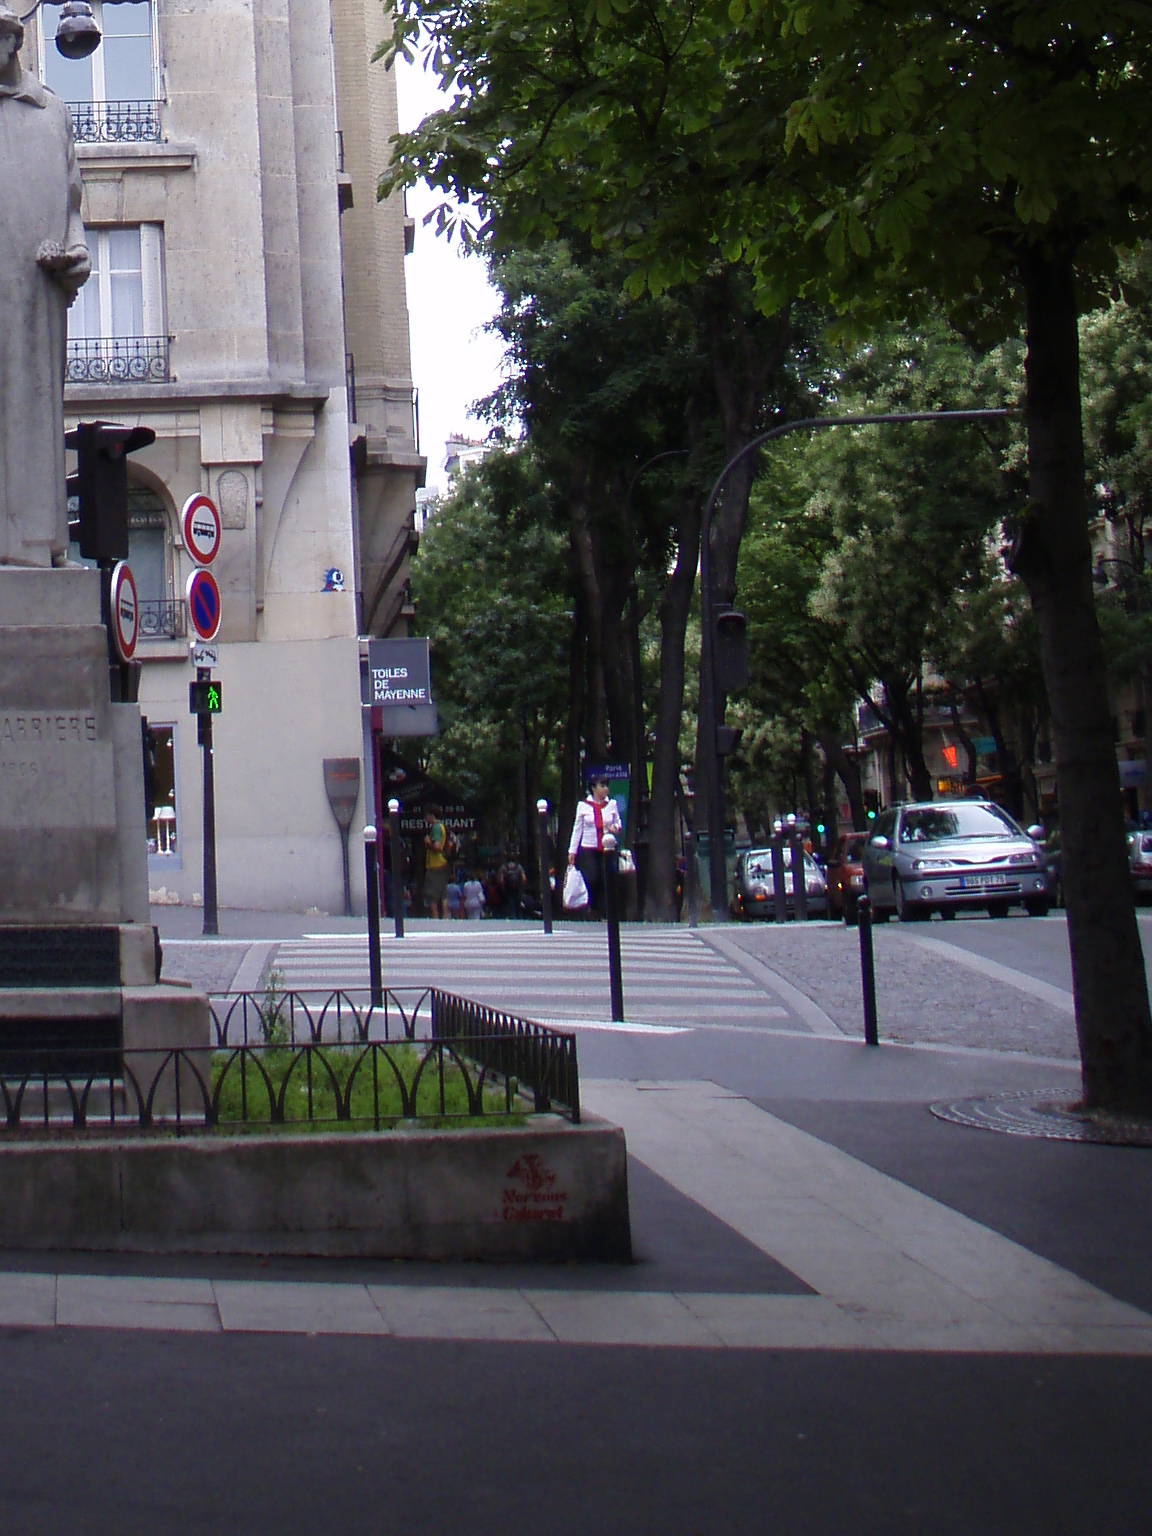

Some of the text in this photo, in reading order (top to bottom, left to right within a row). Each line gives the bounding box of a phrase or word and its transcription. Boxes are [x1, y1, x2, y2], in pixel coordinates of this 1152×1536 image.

[371, 668, 408, 679] TOILES
[374, 679, 389, 689] DE
[374, 688, 426, 700] MAYENNE
